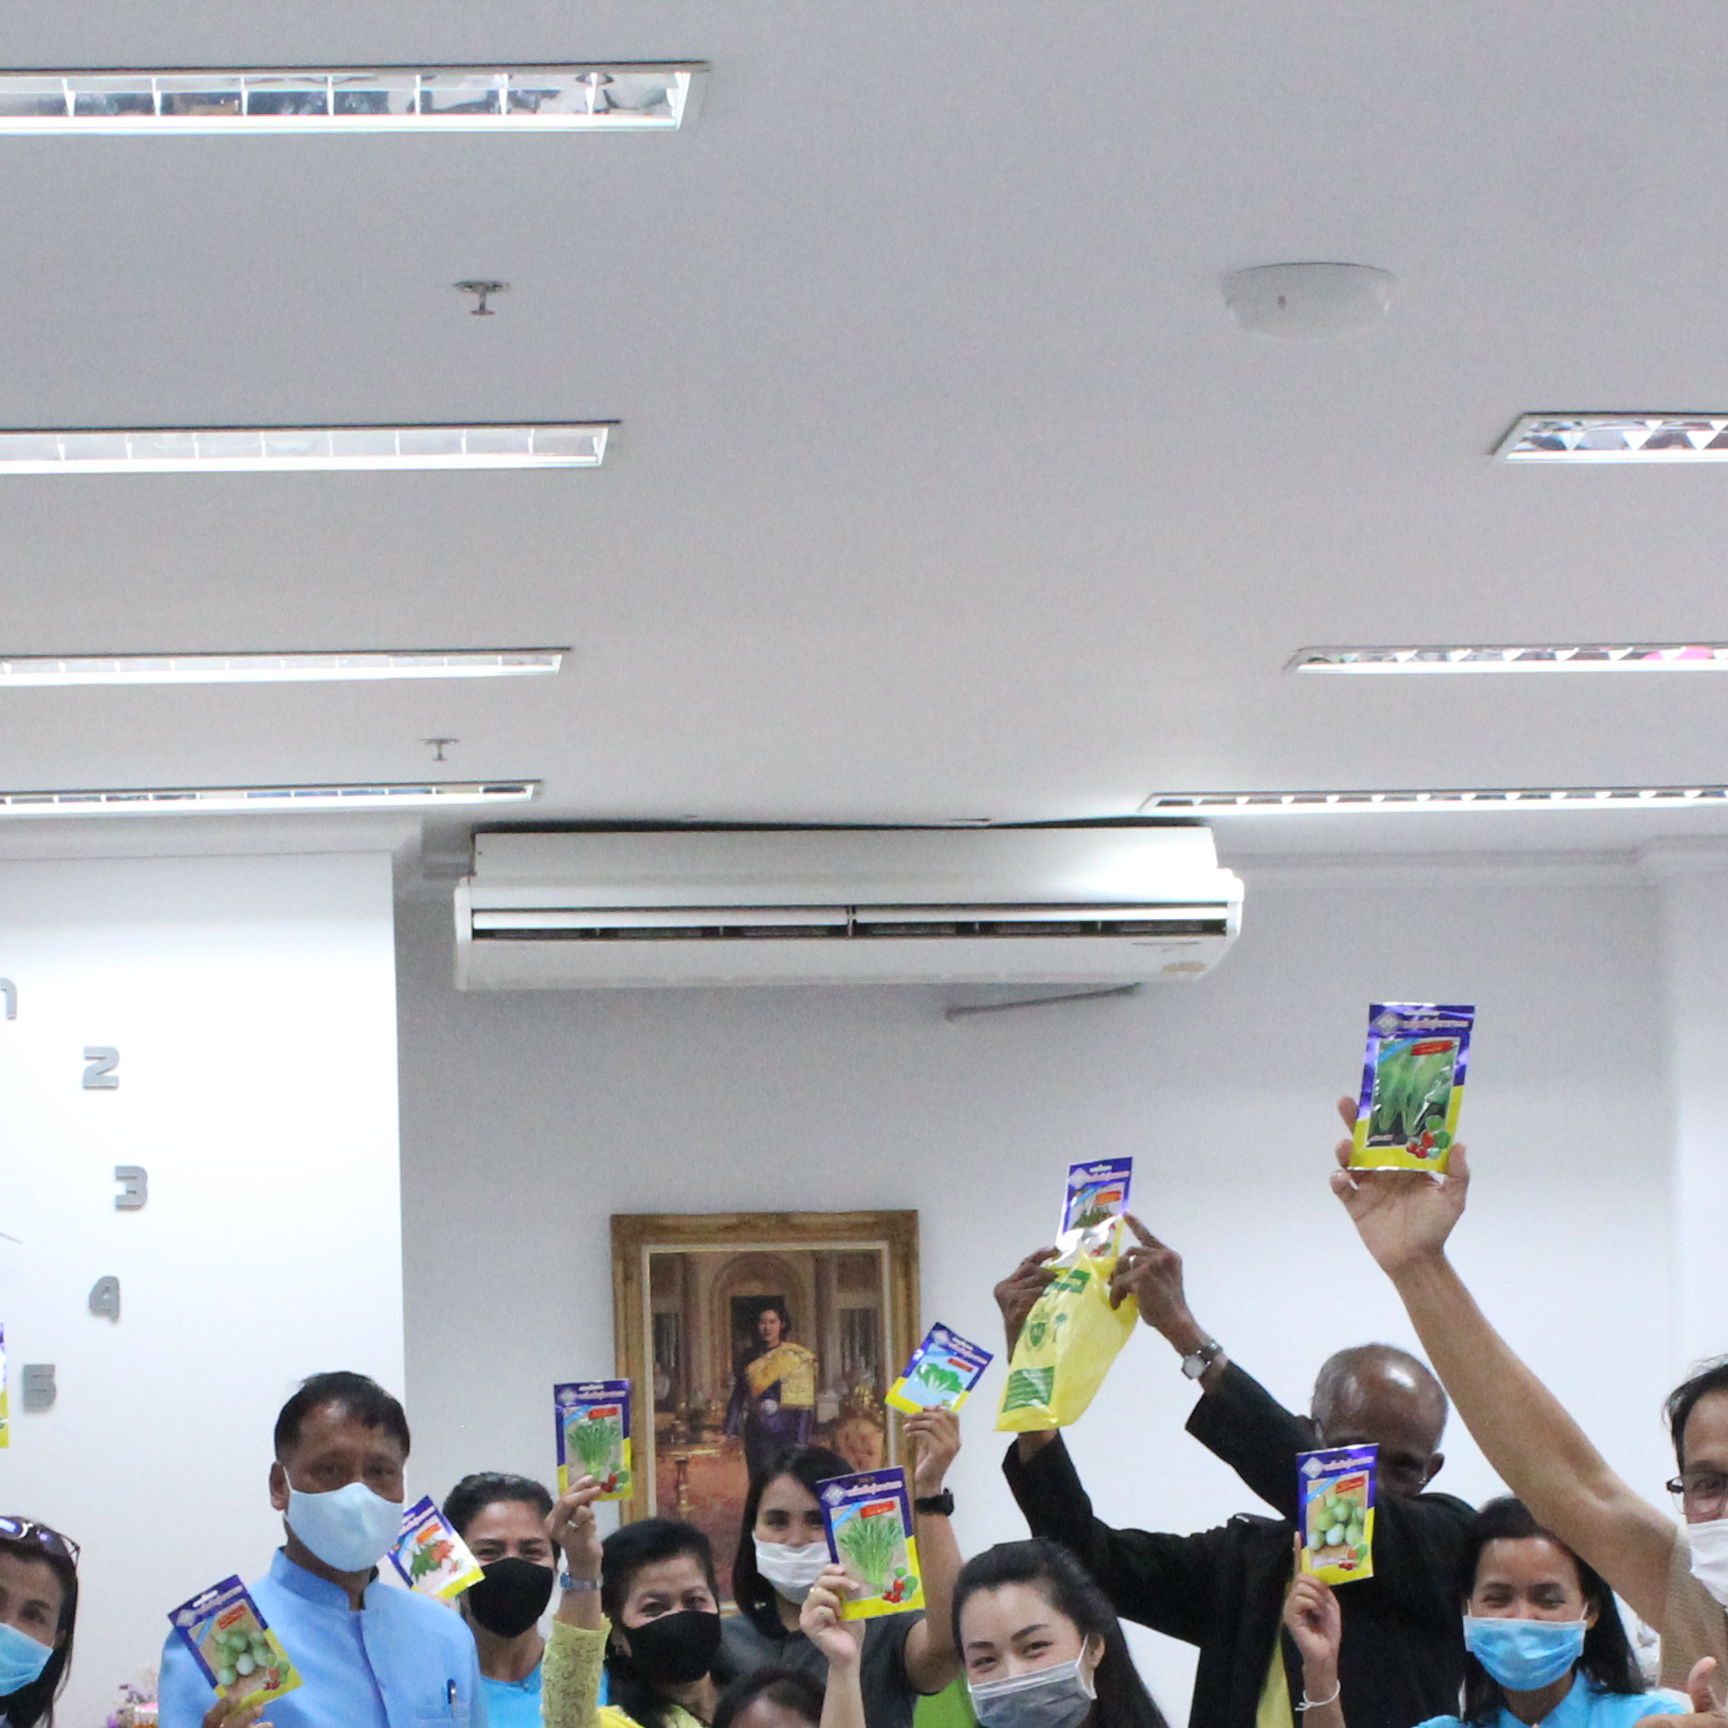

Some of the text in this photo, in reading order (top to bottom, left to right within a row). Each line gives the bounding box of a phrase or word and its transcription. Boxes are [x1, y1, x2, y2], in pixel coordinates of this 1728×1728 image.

[0, 978, 18, 1019] 1
[82, 1046, 120, 1089] 2
[114, 1165, 148, 1210] 3
[88, 1275, 121, 1322] 4
[22, 1363, 56, 1413] 5
